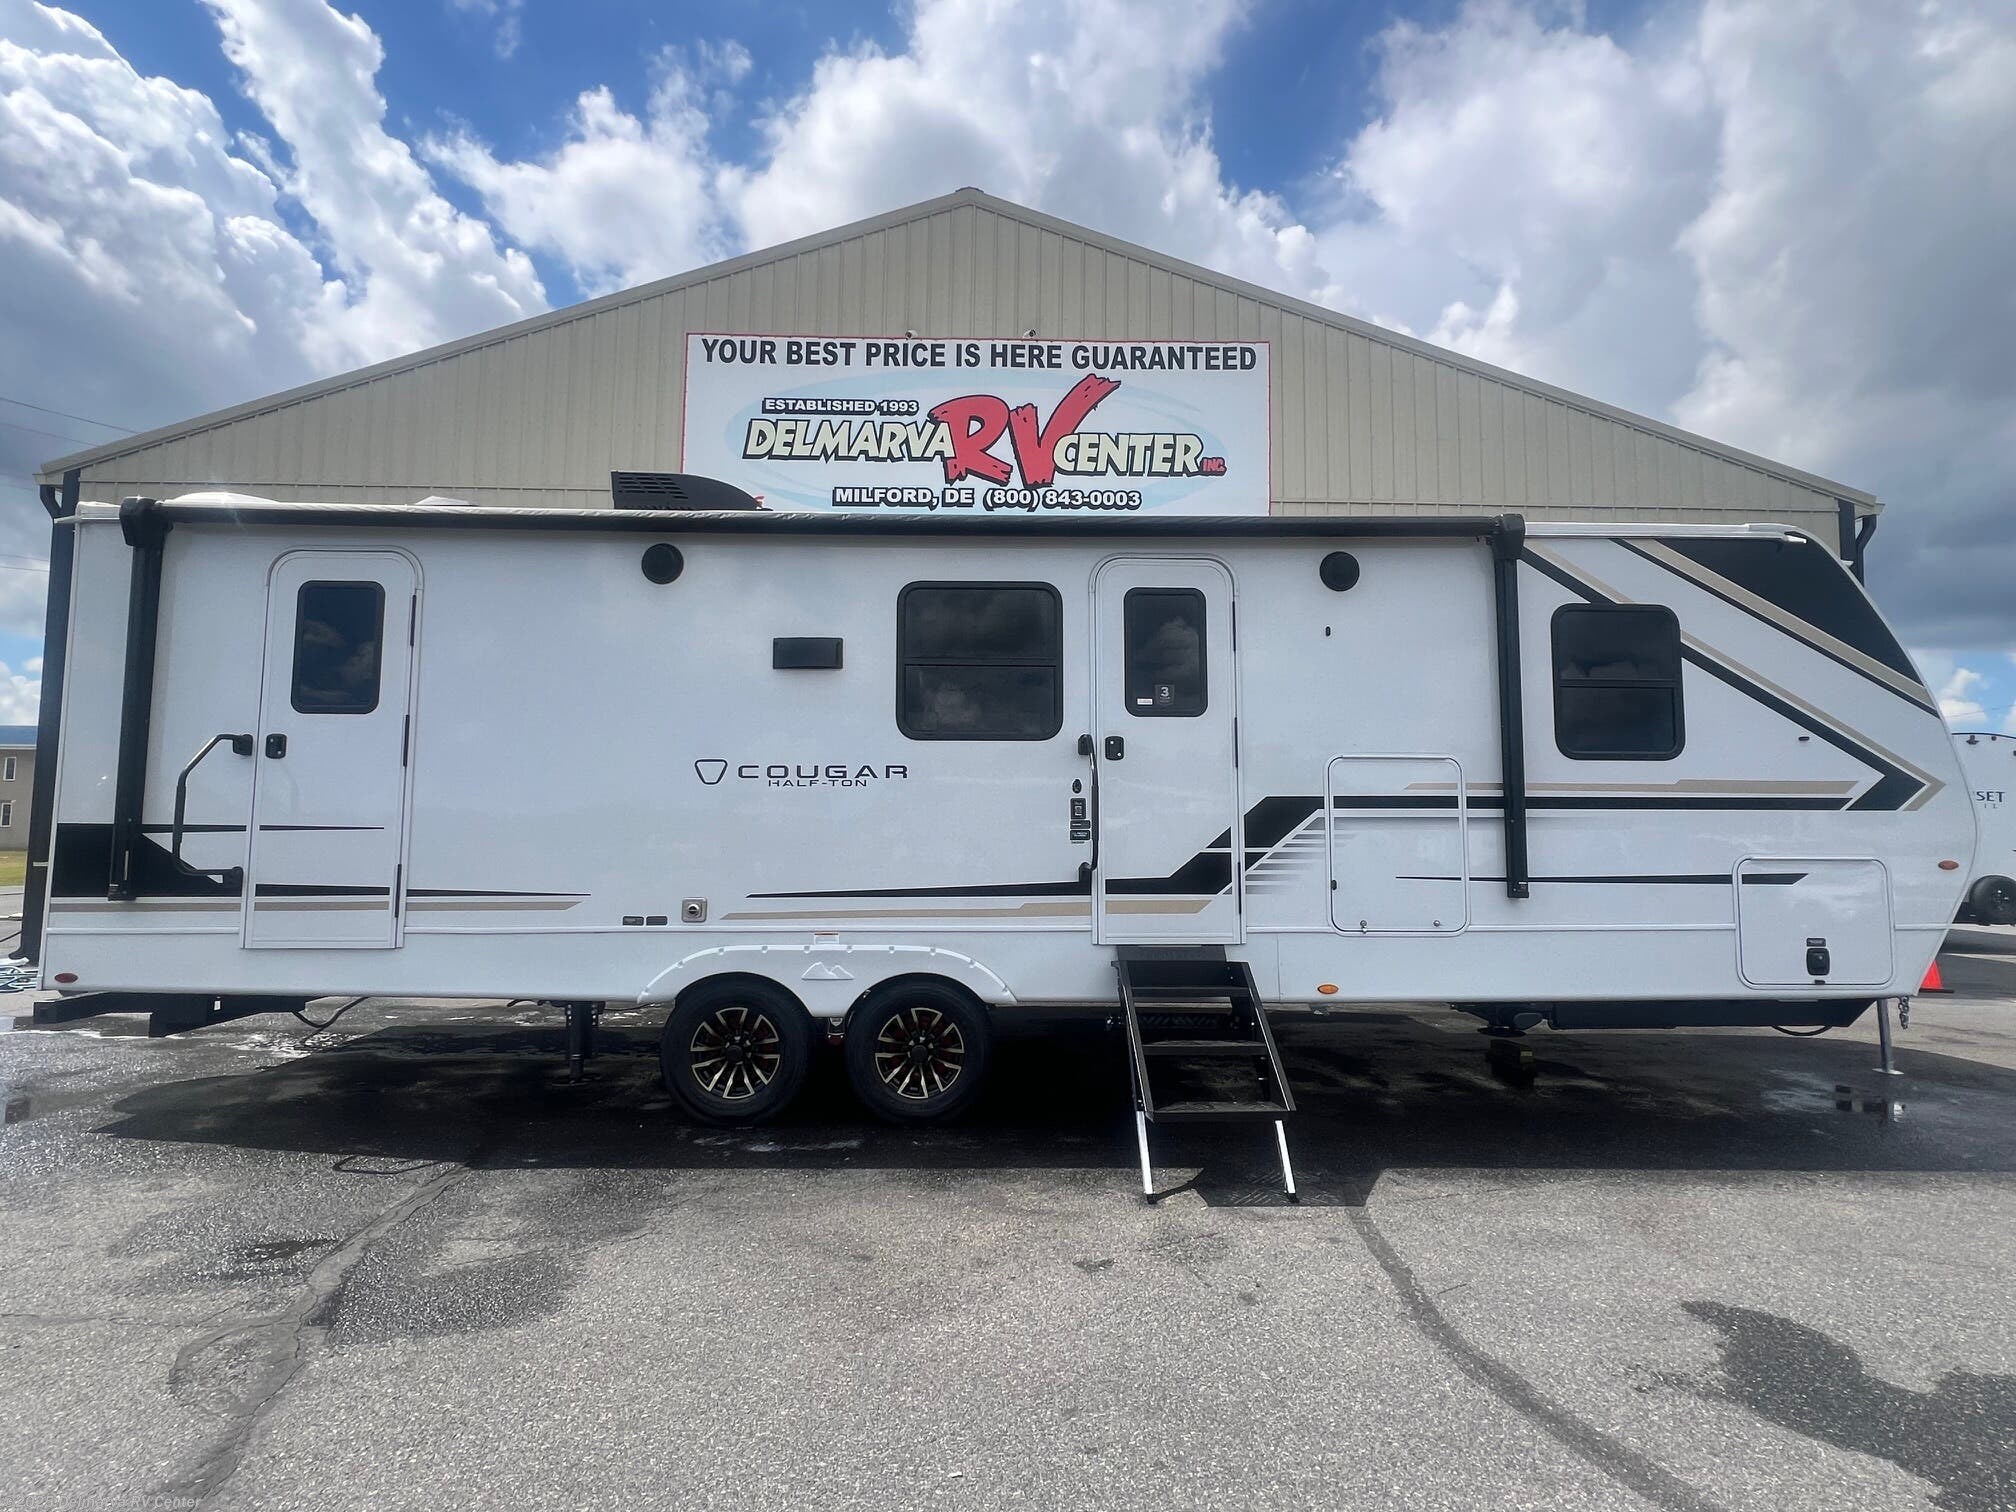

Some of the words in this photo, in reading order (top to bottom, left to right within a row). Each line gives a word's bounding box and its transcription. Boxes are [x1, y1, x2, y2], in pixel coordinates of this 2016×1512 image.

[701, 338, 777, 364] YOUR
[786, 340, 856, 366] BEST
[865, 342, 946, 367] PRICE
[956, 344, 981, 367] IS
[990, 344, 1062, 369] HERE
[1071, 346, 1257, 370] GUARANTEED
[764, 399, 877, 414] ESTABLISHED
[879, 401, 919, 414] 1993
[743, 418, 957, 461] DELMARVA
[927, 373, 1121, 488] RV
[1052, 432, 1204, 476] CENTER
[1201, 457, 1228, 476] INC.
[832, 487, 939, 511] MILFORD,
[942, 489, 975, 507] DE
[983, 488, 1040, 511] (800)
[1043, 489, 1143, 508] 843-0003
[737, 765, 908, 779] COUGAR
[768, 779, 867, 787] HALF-TON
[1973, 790, 2006, 803] SET
